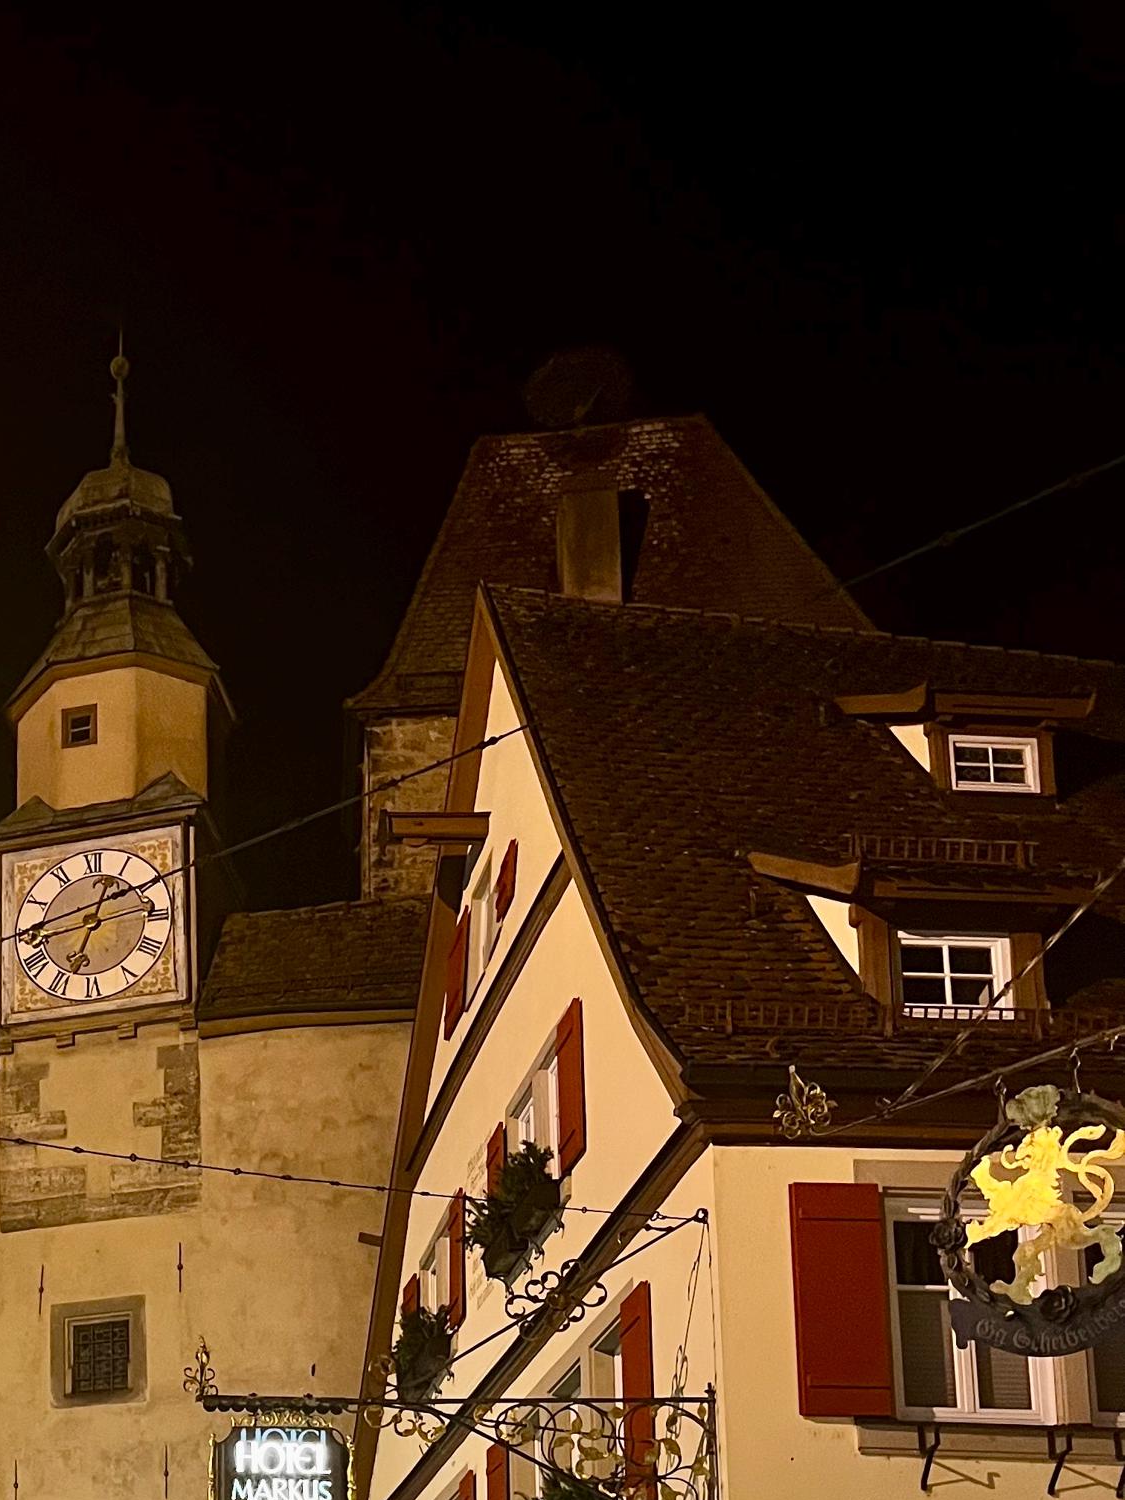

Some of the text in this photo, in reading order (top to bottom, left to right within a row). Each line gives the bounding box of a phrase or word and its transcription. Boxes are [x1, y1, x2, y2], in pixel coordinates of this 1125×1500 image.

[83, 852, 102, 876] XII
[118, 856, 132, 876] I
[50, 865, 70, 889] XI
[26, 894, 48, 911] X
[23, 948, 50, 980] VIII
[120, 964, 139, 985] V
[47, 969, 71, 996] VII
[84, 975, 103, 999] VI
[235, 1440, 332, 1475] HOTEL
